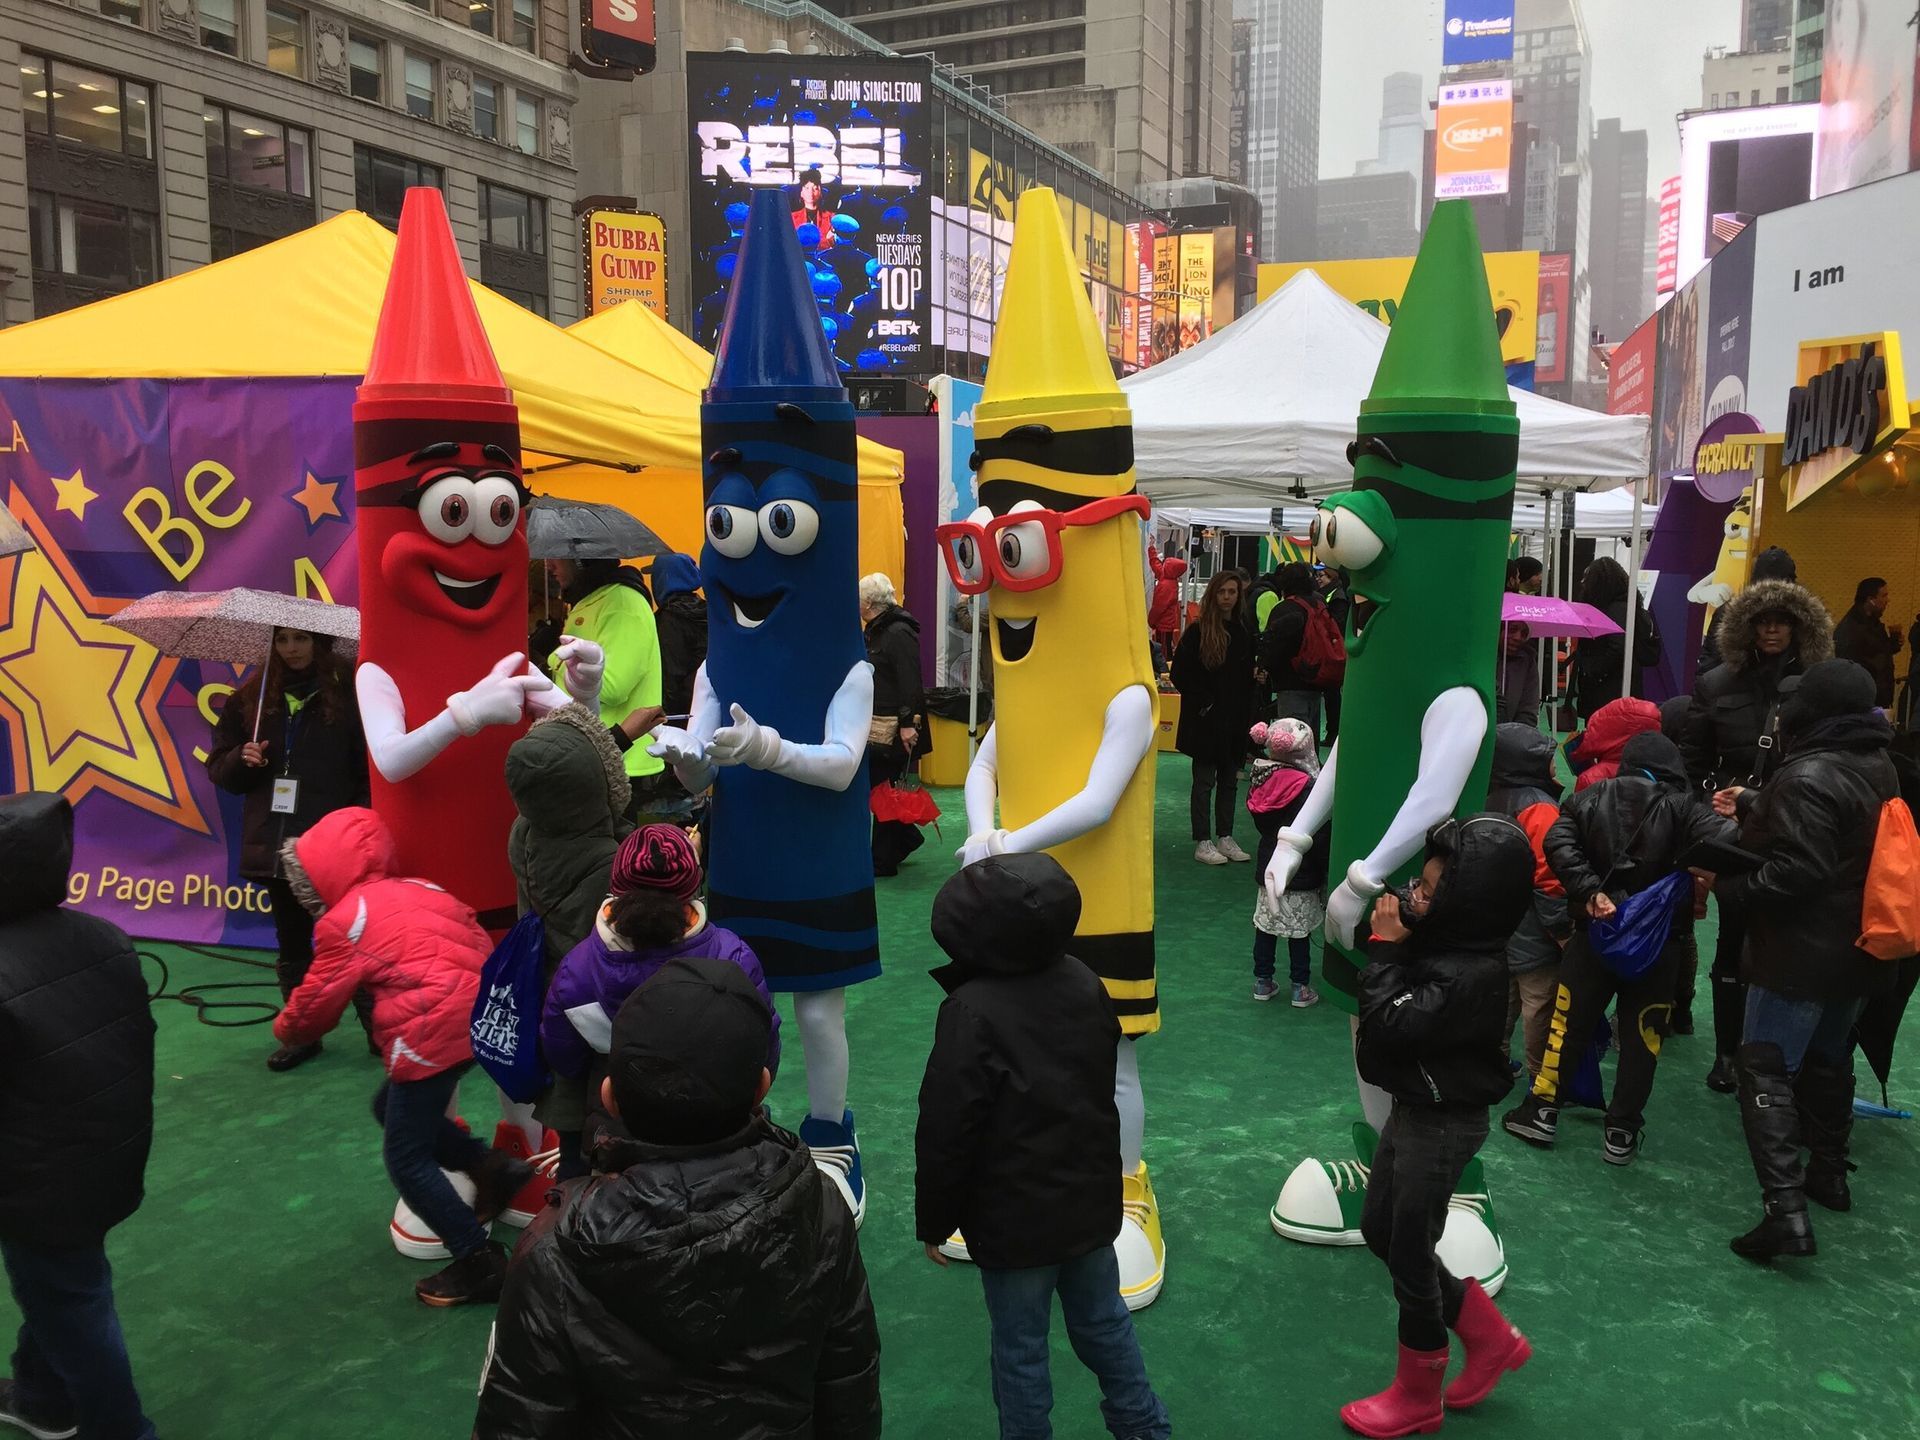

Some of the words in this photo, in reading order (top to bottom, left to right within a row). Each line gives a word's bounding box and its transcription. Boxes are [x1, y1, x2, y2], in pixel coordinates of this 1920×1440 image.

[830, 80, 861, 101] JOHN
[863, 81, 922, 103] SINGLETON
[697, 120, 922, 187] REBEL
[595, 222, 661, 252] BUBBA
[876, 234, 894, 243] NEW
[896, 234, 922, 243] SERIES
[876, 244, 921, 266] TUESDAYS
[1084, 234, 1107, 268] THE
[1188, 258, 1203, 266] THE
[600, 253, 657, 280] GUMP
[1185, 268, 1207, 282] LION
[1794, 269, 1801, 292] I
[1808, 265, 1844, 288] am
[606, 287, 653, 297] SHRIMP
[877, 267, 922, 310] 10P
[1182, 283, 1210, 300] KING
[878, 320, 912, 336] BET
[1782, 342, 1886, 467] DAND'S
[1697, 442, 1756, 476] #CRAYOLA
[122, 458, 252, 583] Be
[97, 867, 174, 910] Page
